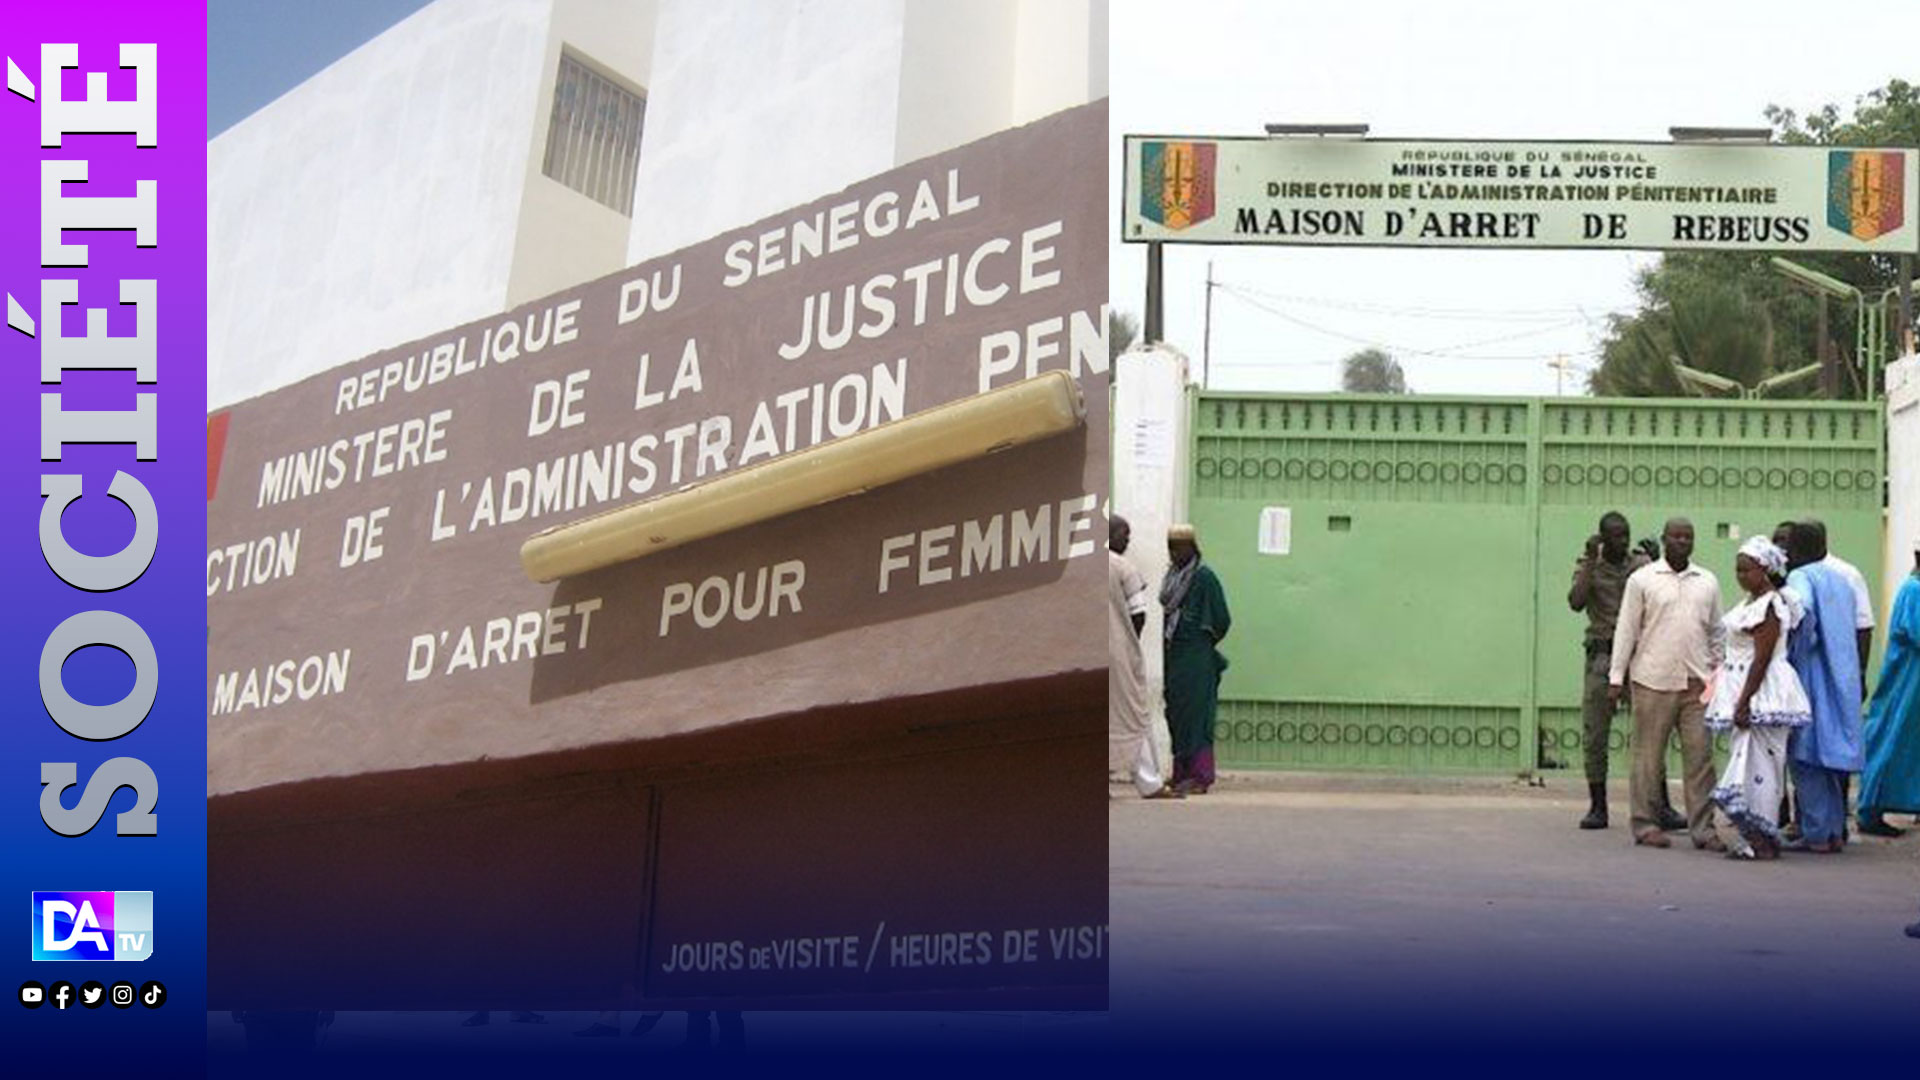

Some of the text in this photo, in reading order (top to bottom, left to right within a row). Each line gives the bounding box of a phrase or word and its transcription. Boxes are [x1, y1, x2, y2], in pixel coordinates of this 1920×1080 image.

[1392, 164, 1657, 179] MINISTERE DE LA JUSTICE
[1526, 152, 1550, 162] DU
[1267, 181, 1777, 203] DIRECTION DE L'ADMINISTRATION PÉNITENTIAIRE
[1234, 207, 1809, 243] MAISON D'ARRET DE REBEUSS
[335, 168, 980, 415] REPUBLIQUE DU SENEGAL
[258, 220, 1063, 508] MINISTERE DE LA JUSTICE
[207, 528, 300, 597] CTION
[339, 507, 390, 568] DE
[431, 358, 908, 541] L'ADMINISTRATION
[212, 493, 1109, 716] MAISON D'ARRET POUR FEMME
[662, 940, 745, 973] JOURS
[748, 946, 770, 971] DE
[770, 935, 859, 970] VISITE
[890, 931, 993, 967] HEURES
[1002, 929, 1039, 963] DE
[1049, 925, 1109, 960] VISI
